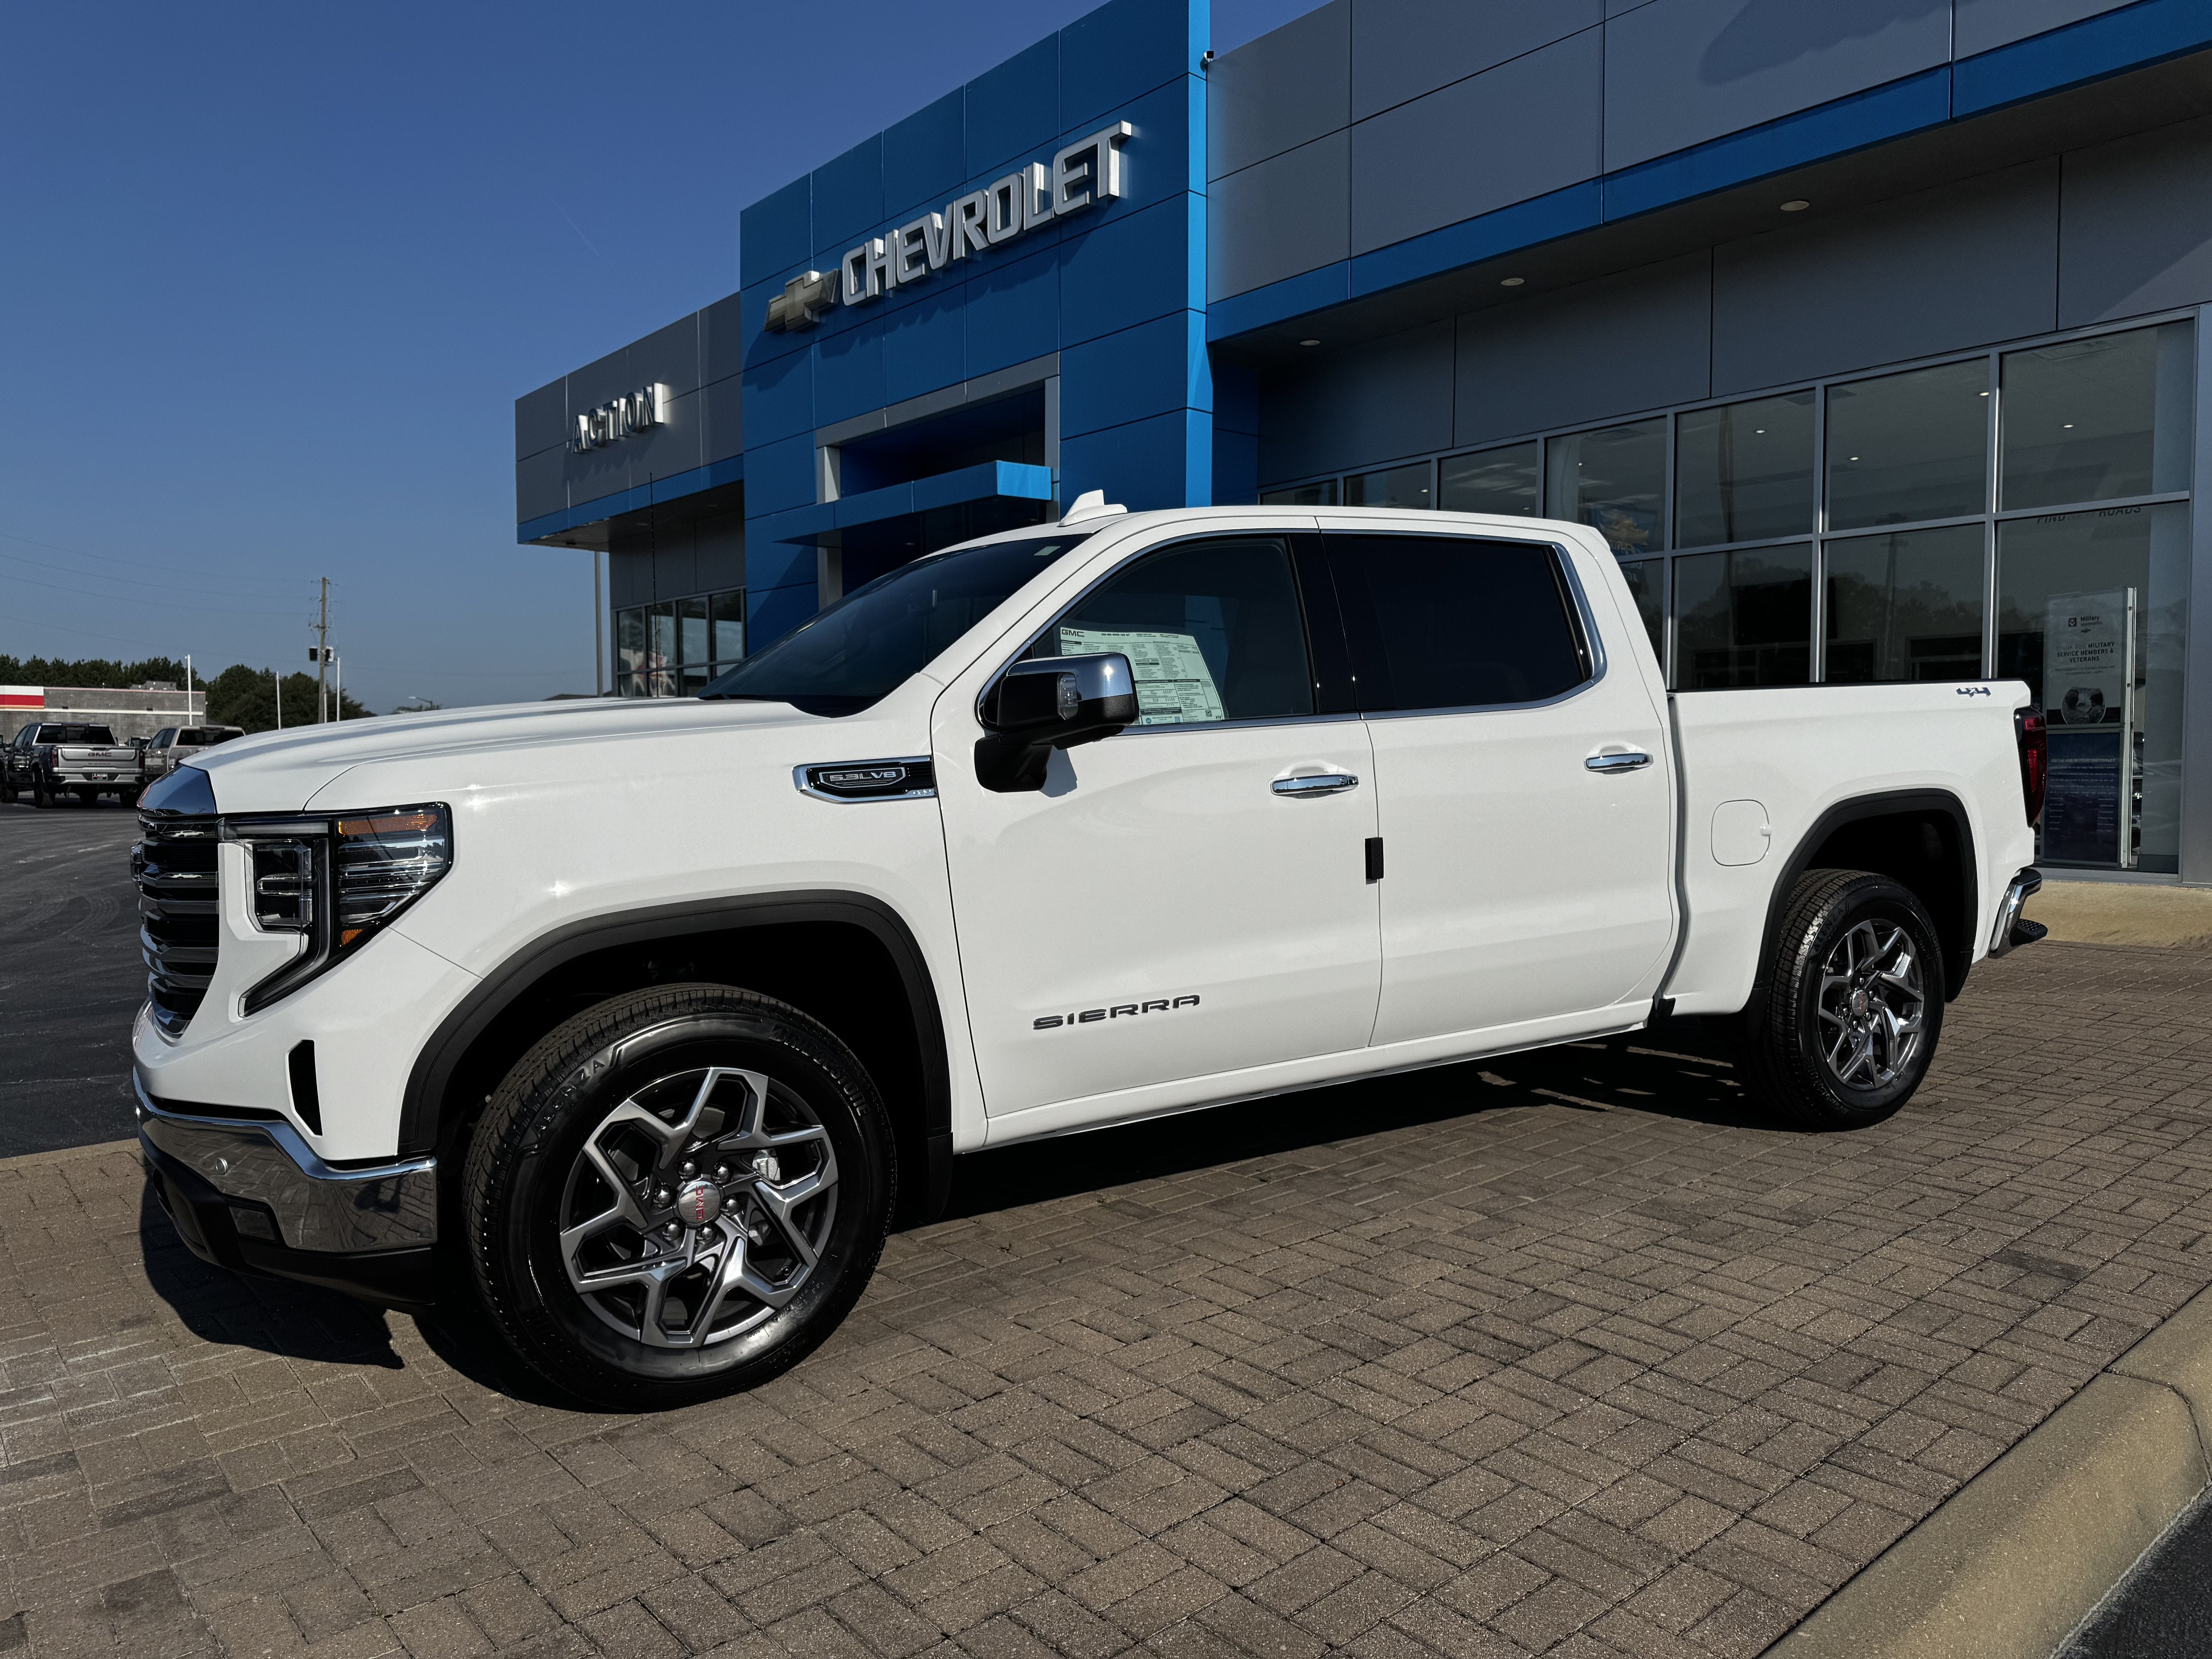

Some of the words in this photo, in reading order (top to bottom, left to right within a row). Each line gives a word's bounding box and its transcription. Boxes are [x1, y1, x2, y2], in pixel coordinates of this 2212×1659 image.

[842, 120, 1132, 306] CHEVROLET
[572, 383, 663, 453] ACTION
[1033, 995, 1200, 1030] SIERRA
[534, 1060, 606, 1138] ALENZA
[769, 1024, 870, 1116] BRIDGESTONE
[696, 1185, 704, 1221] GMC
